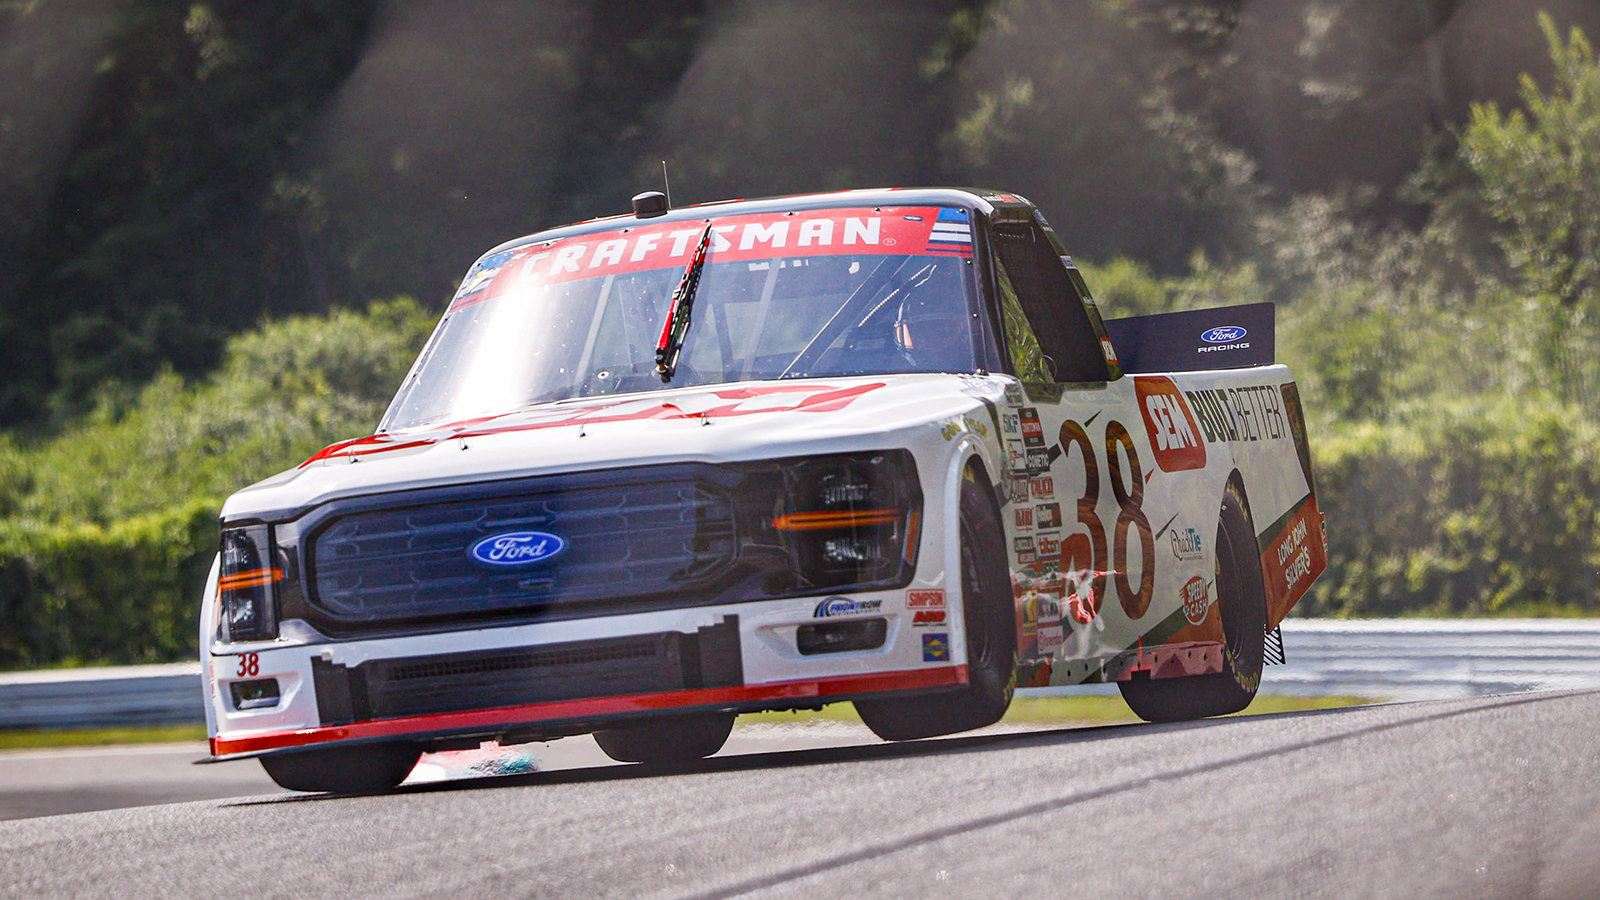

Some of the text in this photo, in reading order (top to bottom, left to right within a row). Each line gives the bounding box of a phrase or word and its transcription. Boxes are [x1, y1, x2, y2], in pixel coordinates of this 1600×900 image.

[518, 217, 881, 280] CRAFTSMAN
[1197, 342, 1250, 353] RACING
[1210, 328, 1239, 341] Ford
[1145, 393, 1198, 451] SEM
[1185, 385, 1287, 442] BUILT BETTER
[1058, 419, 1156, 620] 38
[488, 535, 548, 560] Ford
[1277, 518, 1308, 566] LONG JOHN
[1285, 546, 1311, 590] SILVER'S
[908, 591, 944, 607] SIMPSON
[1190, 598, 1208, 617] CASH
[236, 652, 259, 677] 38
